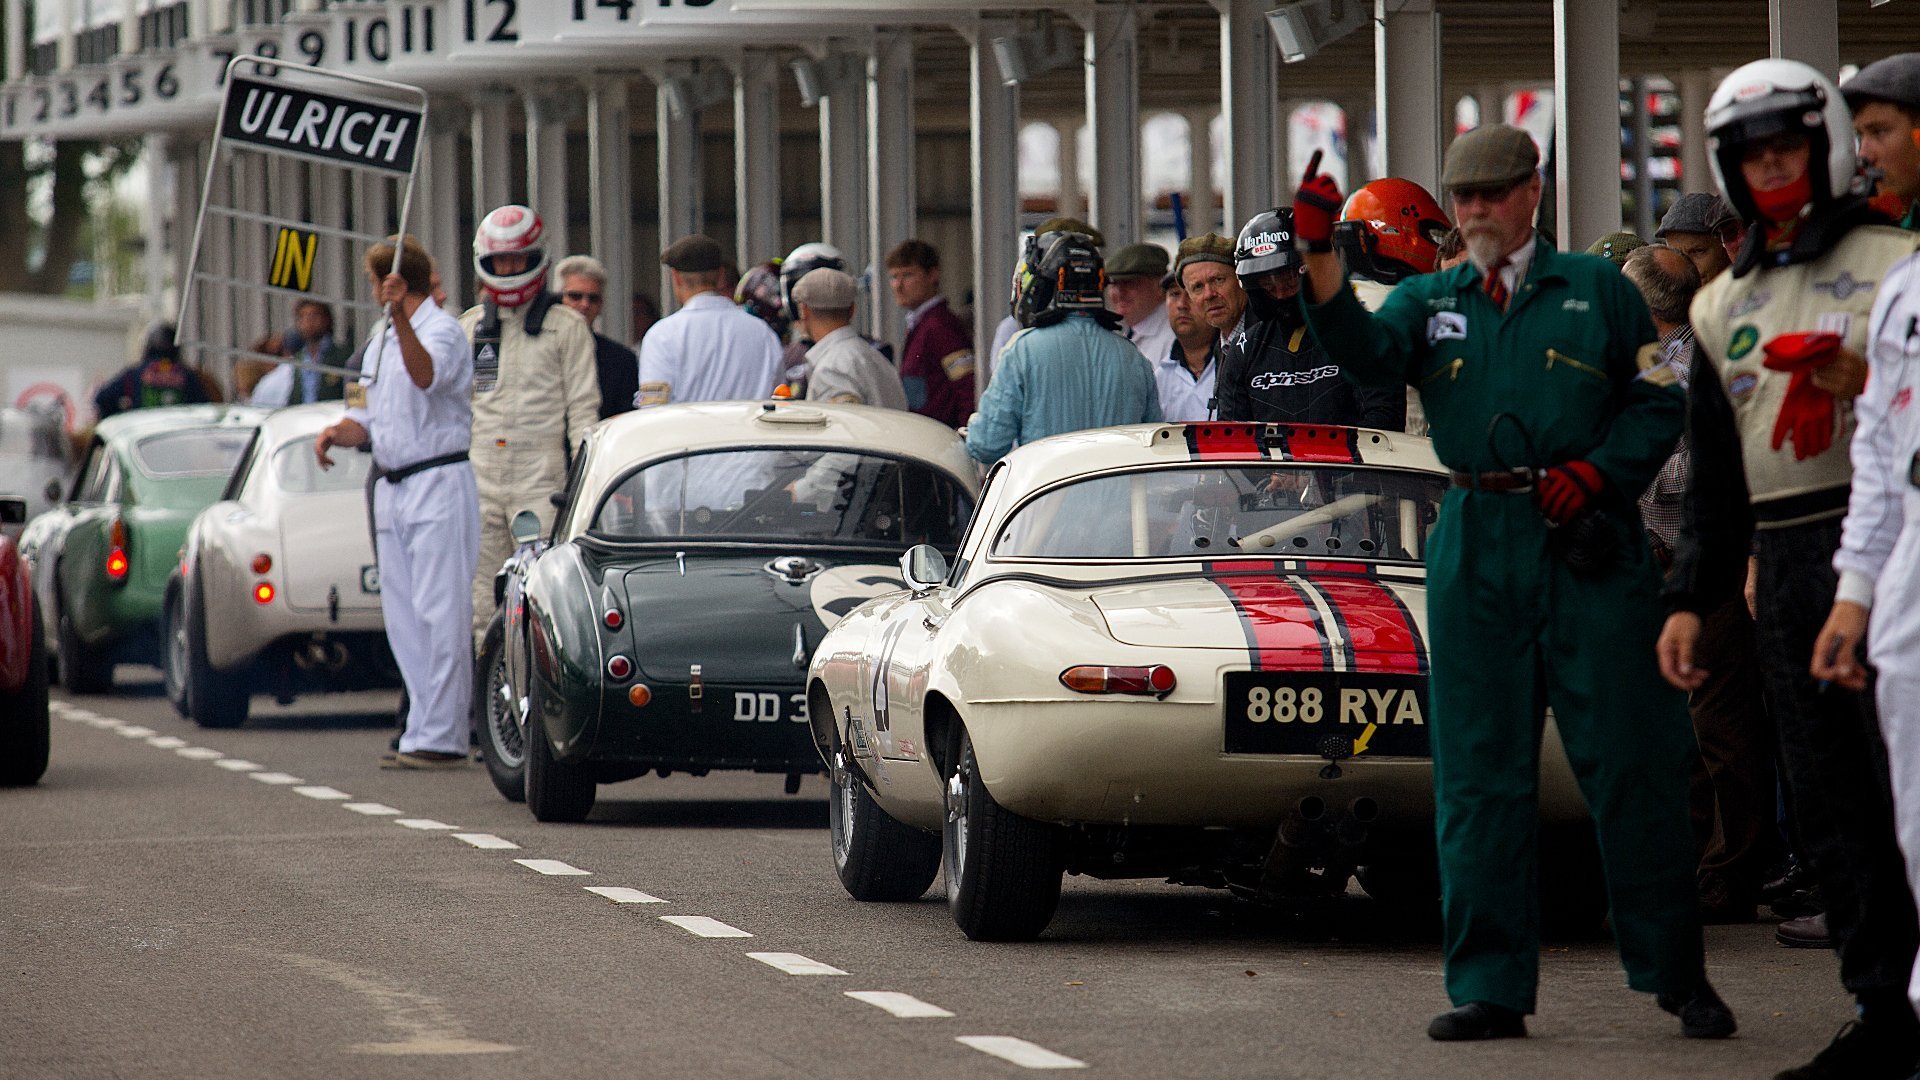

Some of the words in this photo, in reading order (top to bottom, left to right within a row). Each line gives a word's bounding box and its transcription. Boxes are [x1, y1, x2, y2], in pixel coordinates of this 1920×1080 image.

[58, 80, 78, 117] 3
[86, 78, 110, 113] 4
[120, 68, 143, 105] 5
[155, 64, 180, 100] 6
[212, 51, 234, 86] 7
[254, 41, 278, 77] 8
[300, 30, 325, 67] 9
[346, 19, 391, 63] 10
[403, 6, 434, 53] 11
[464, 0, 519, 42] 12
[239, 88, 411, 163] ULRICH
[270, 227, 318, 291] IN
[1243, 230, 1290, 251] Marlboro
[1254, 245, 1274, 253] BELL
[734, 691, 781, 722] DD
[789, 693, 810, 723] 3
[1247, 686, 1324, 724] 888
[1340, 688, 1425, 725] RYA
